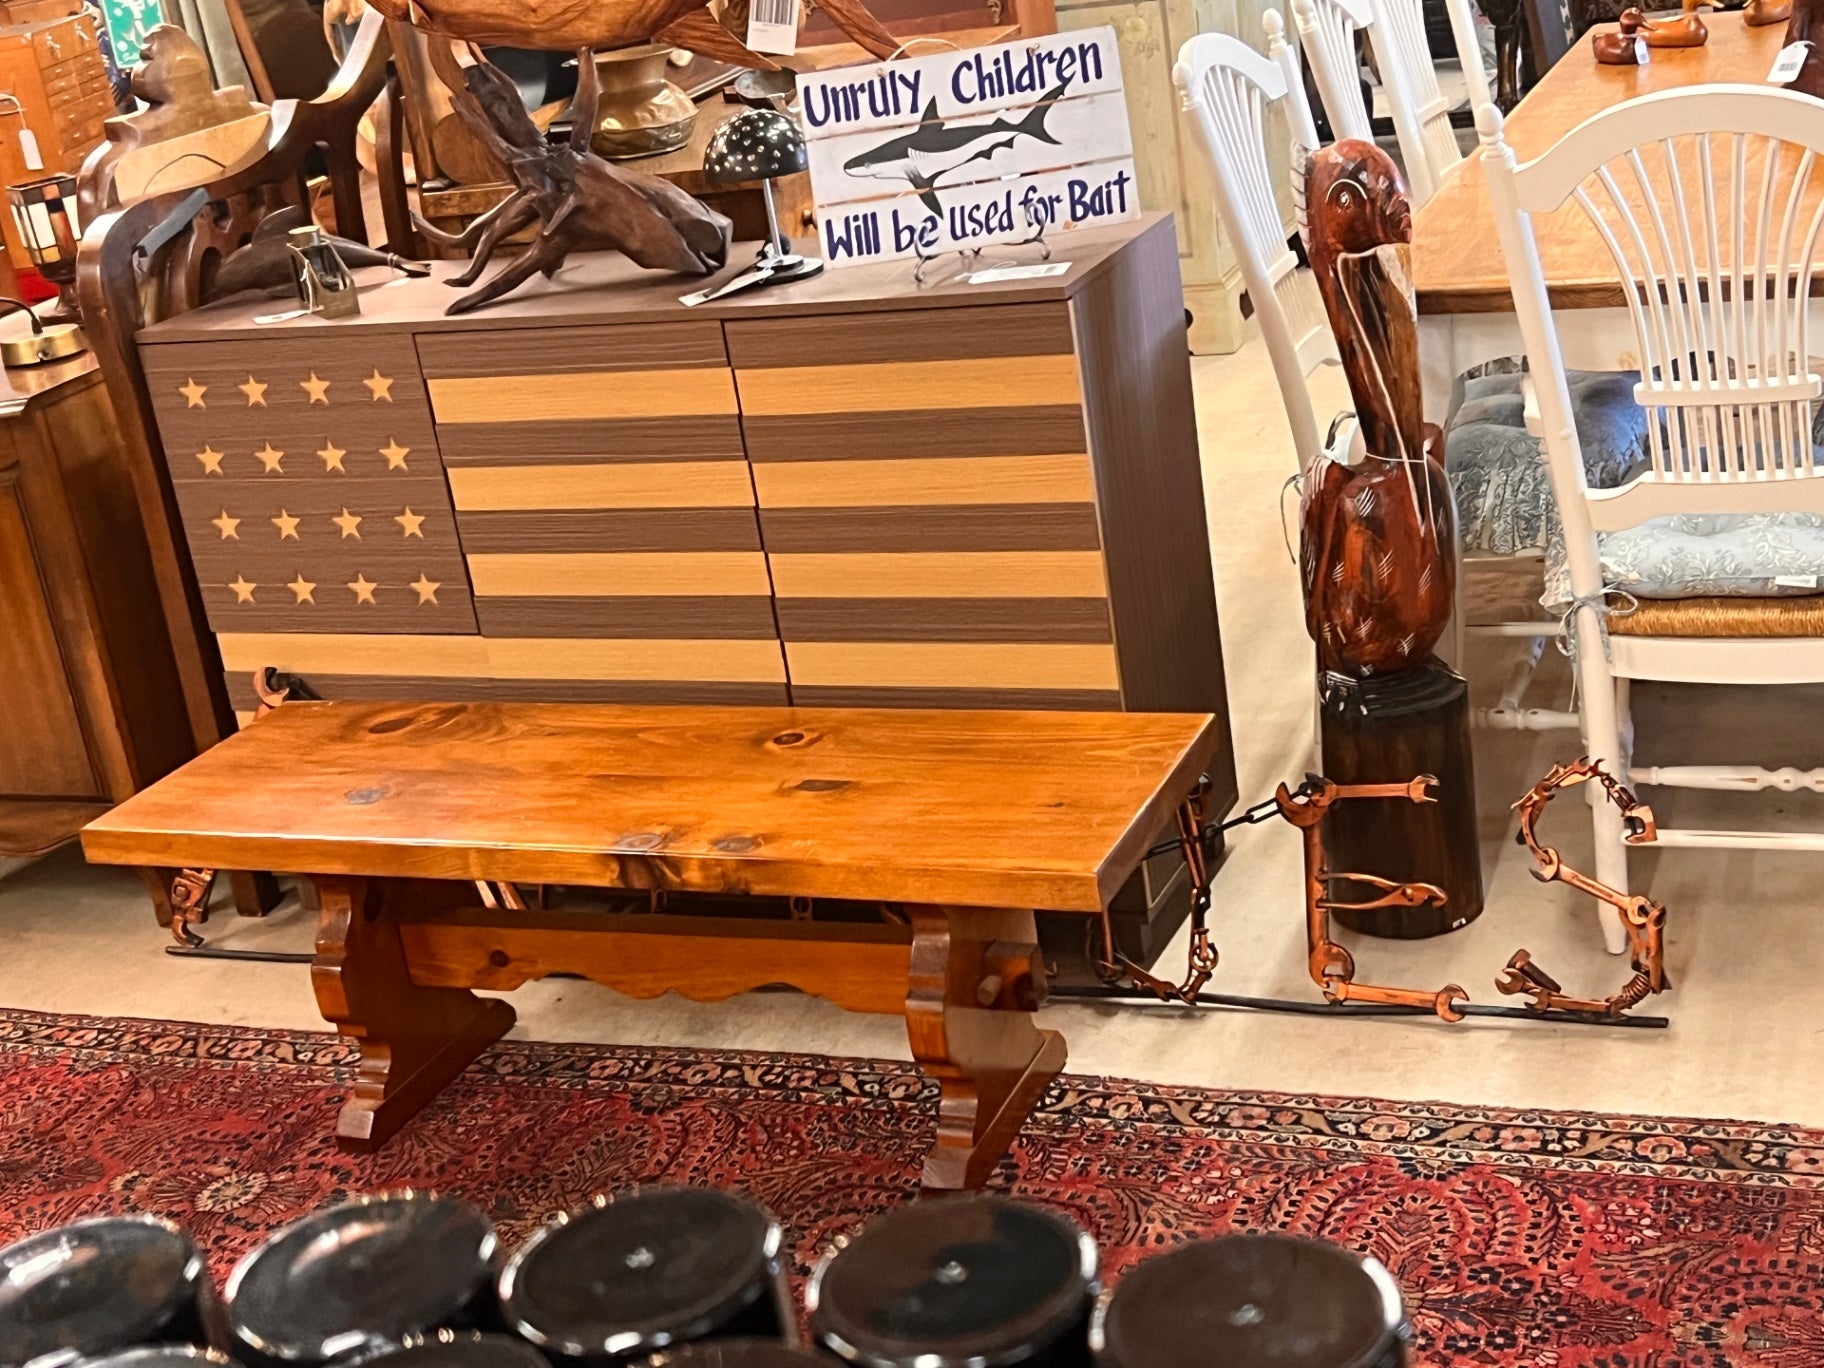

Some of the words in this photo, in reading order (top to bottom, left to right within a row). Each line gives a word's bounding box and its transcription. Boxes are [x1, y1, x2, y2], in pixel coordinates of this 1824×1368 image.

[803, 69, 921, 127] Unruly
[951, 42, 1103, 104] Children
[825, 211, 881, 260] Will
[892, 209, 939, 252] be
[1018, 185, 1063, 226] for
[1068, 170, 1131, 222] Bait
